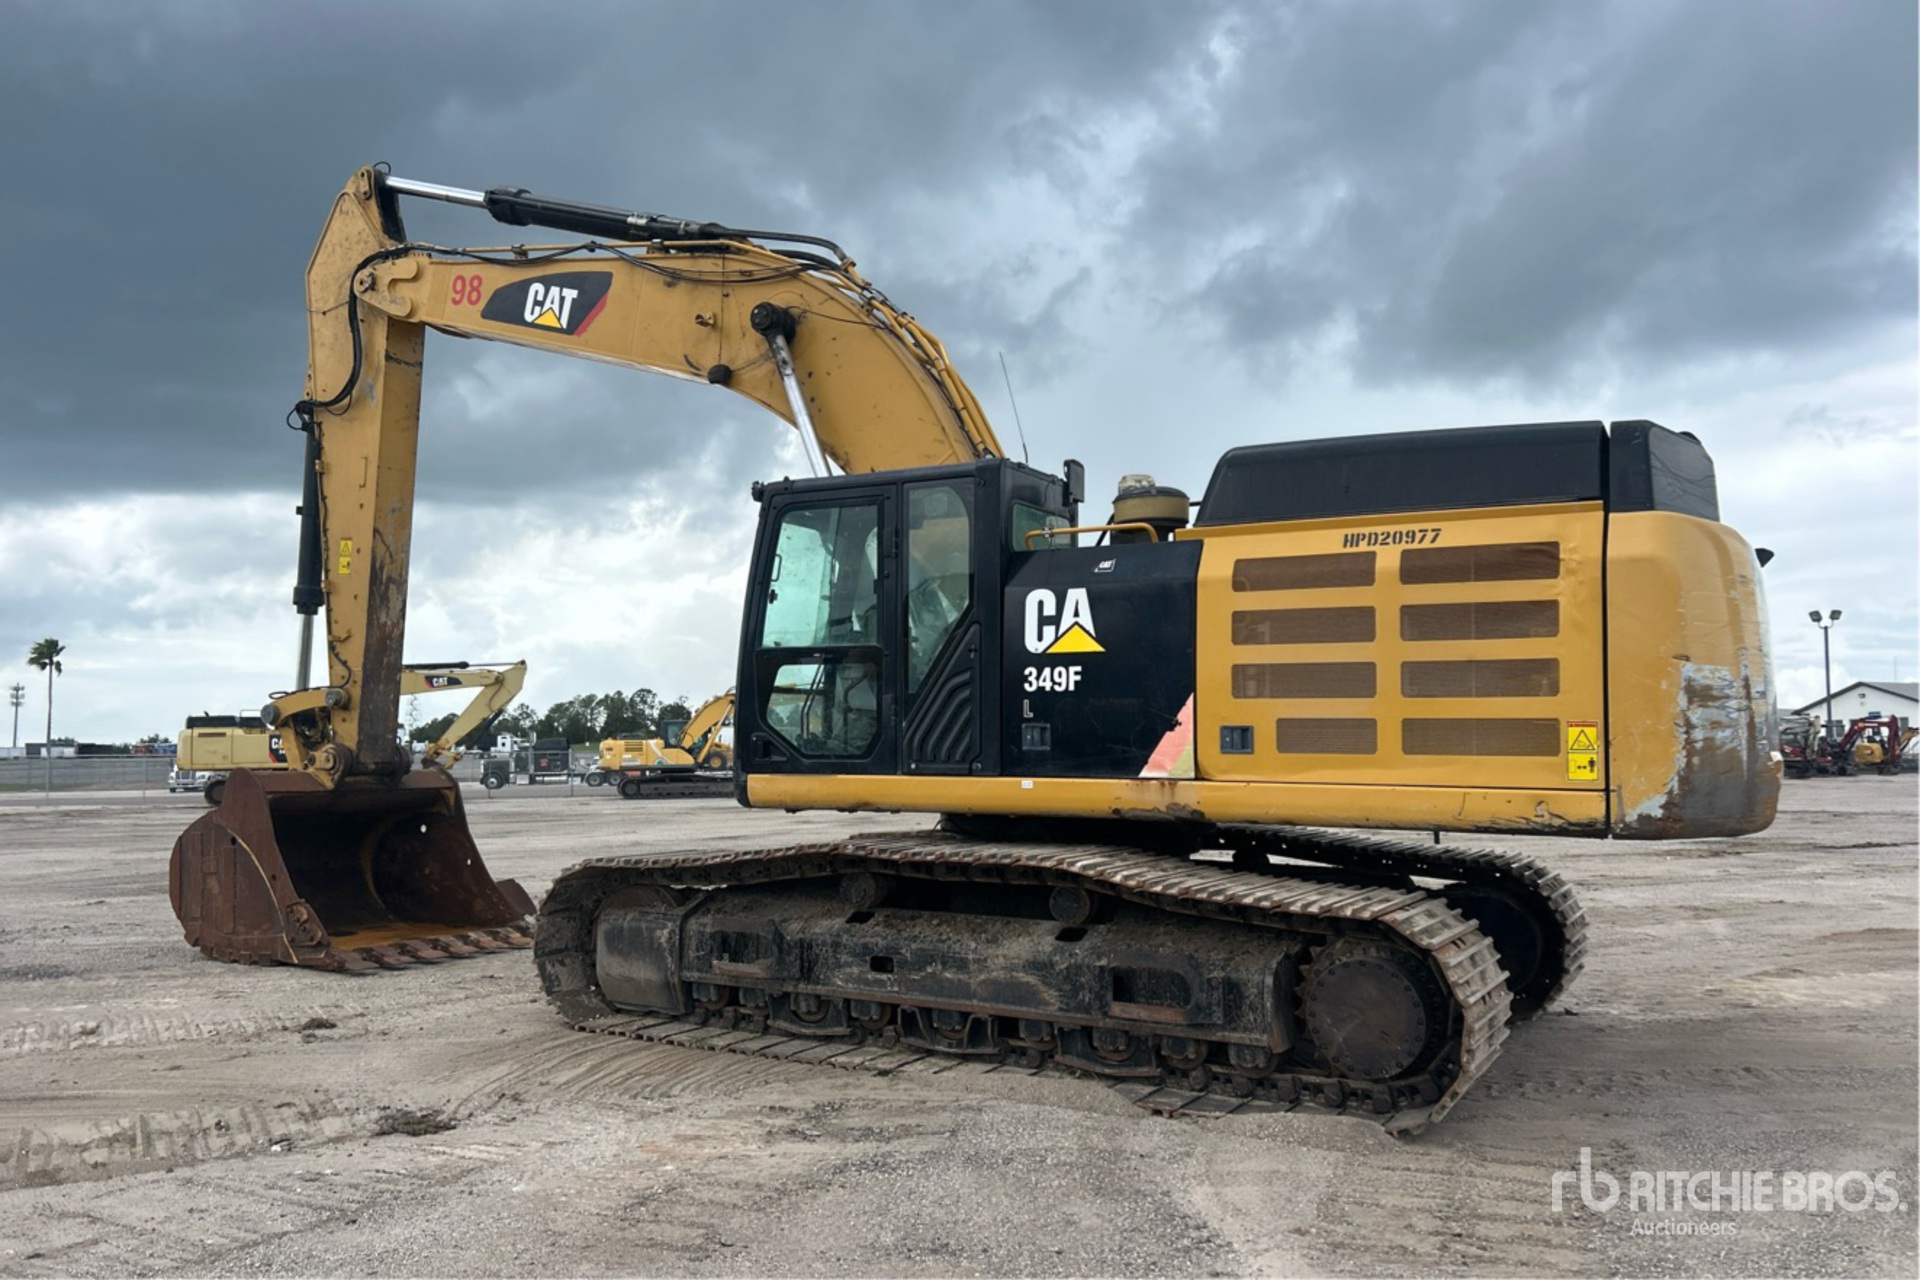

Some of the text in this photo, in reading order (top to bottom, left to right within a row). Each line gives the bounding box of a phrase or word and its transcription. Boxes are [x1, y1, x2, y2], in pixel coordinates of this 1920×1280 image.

[451, 274, 483, 306] 98
[524, 282, 579, 329] CAT
[1342, 528, 1442, 548] HPD20977
[432, 677, 448, 687] CAT
[1024, 665, 1082, 692] 349F
[1023, 699, 1034, 718] L
